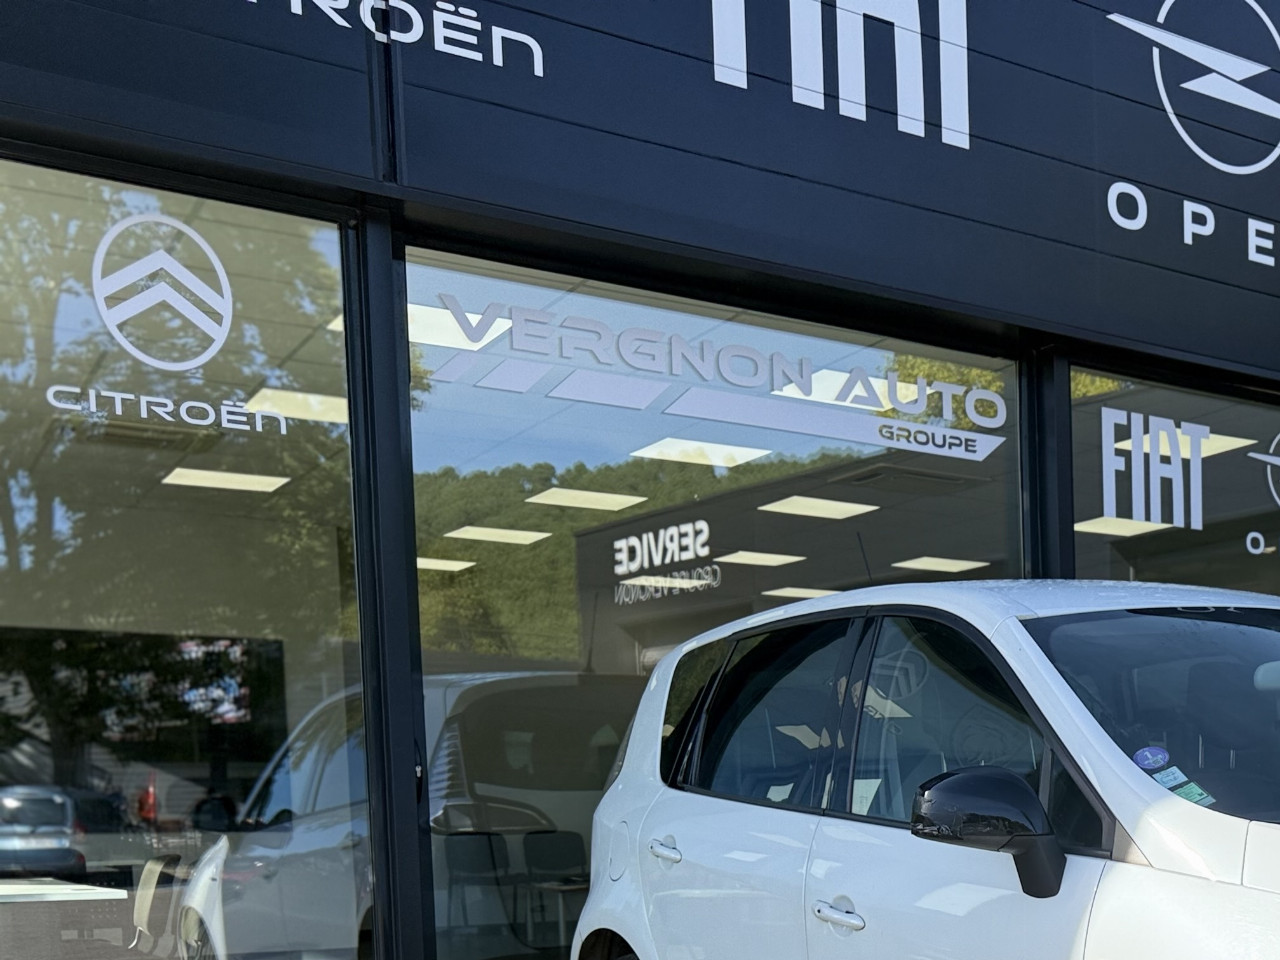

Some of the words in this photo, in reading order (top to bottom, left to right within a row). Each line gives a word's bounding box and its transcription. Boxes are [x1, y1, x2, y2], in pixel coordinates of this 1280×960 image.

[438, 293, 813, 397] VERGNON
[835, 367, 1007, 429] AUTO
[878, 424, 978, 454] GROUPE
[1101, 407, 1211, 531] FIAT
